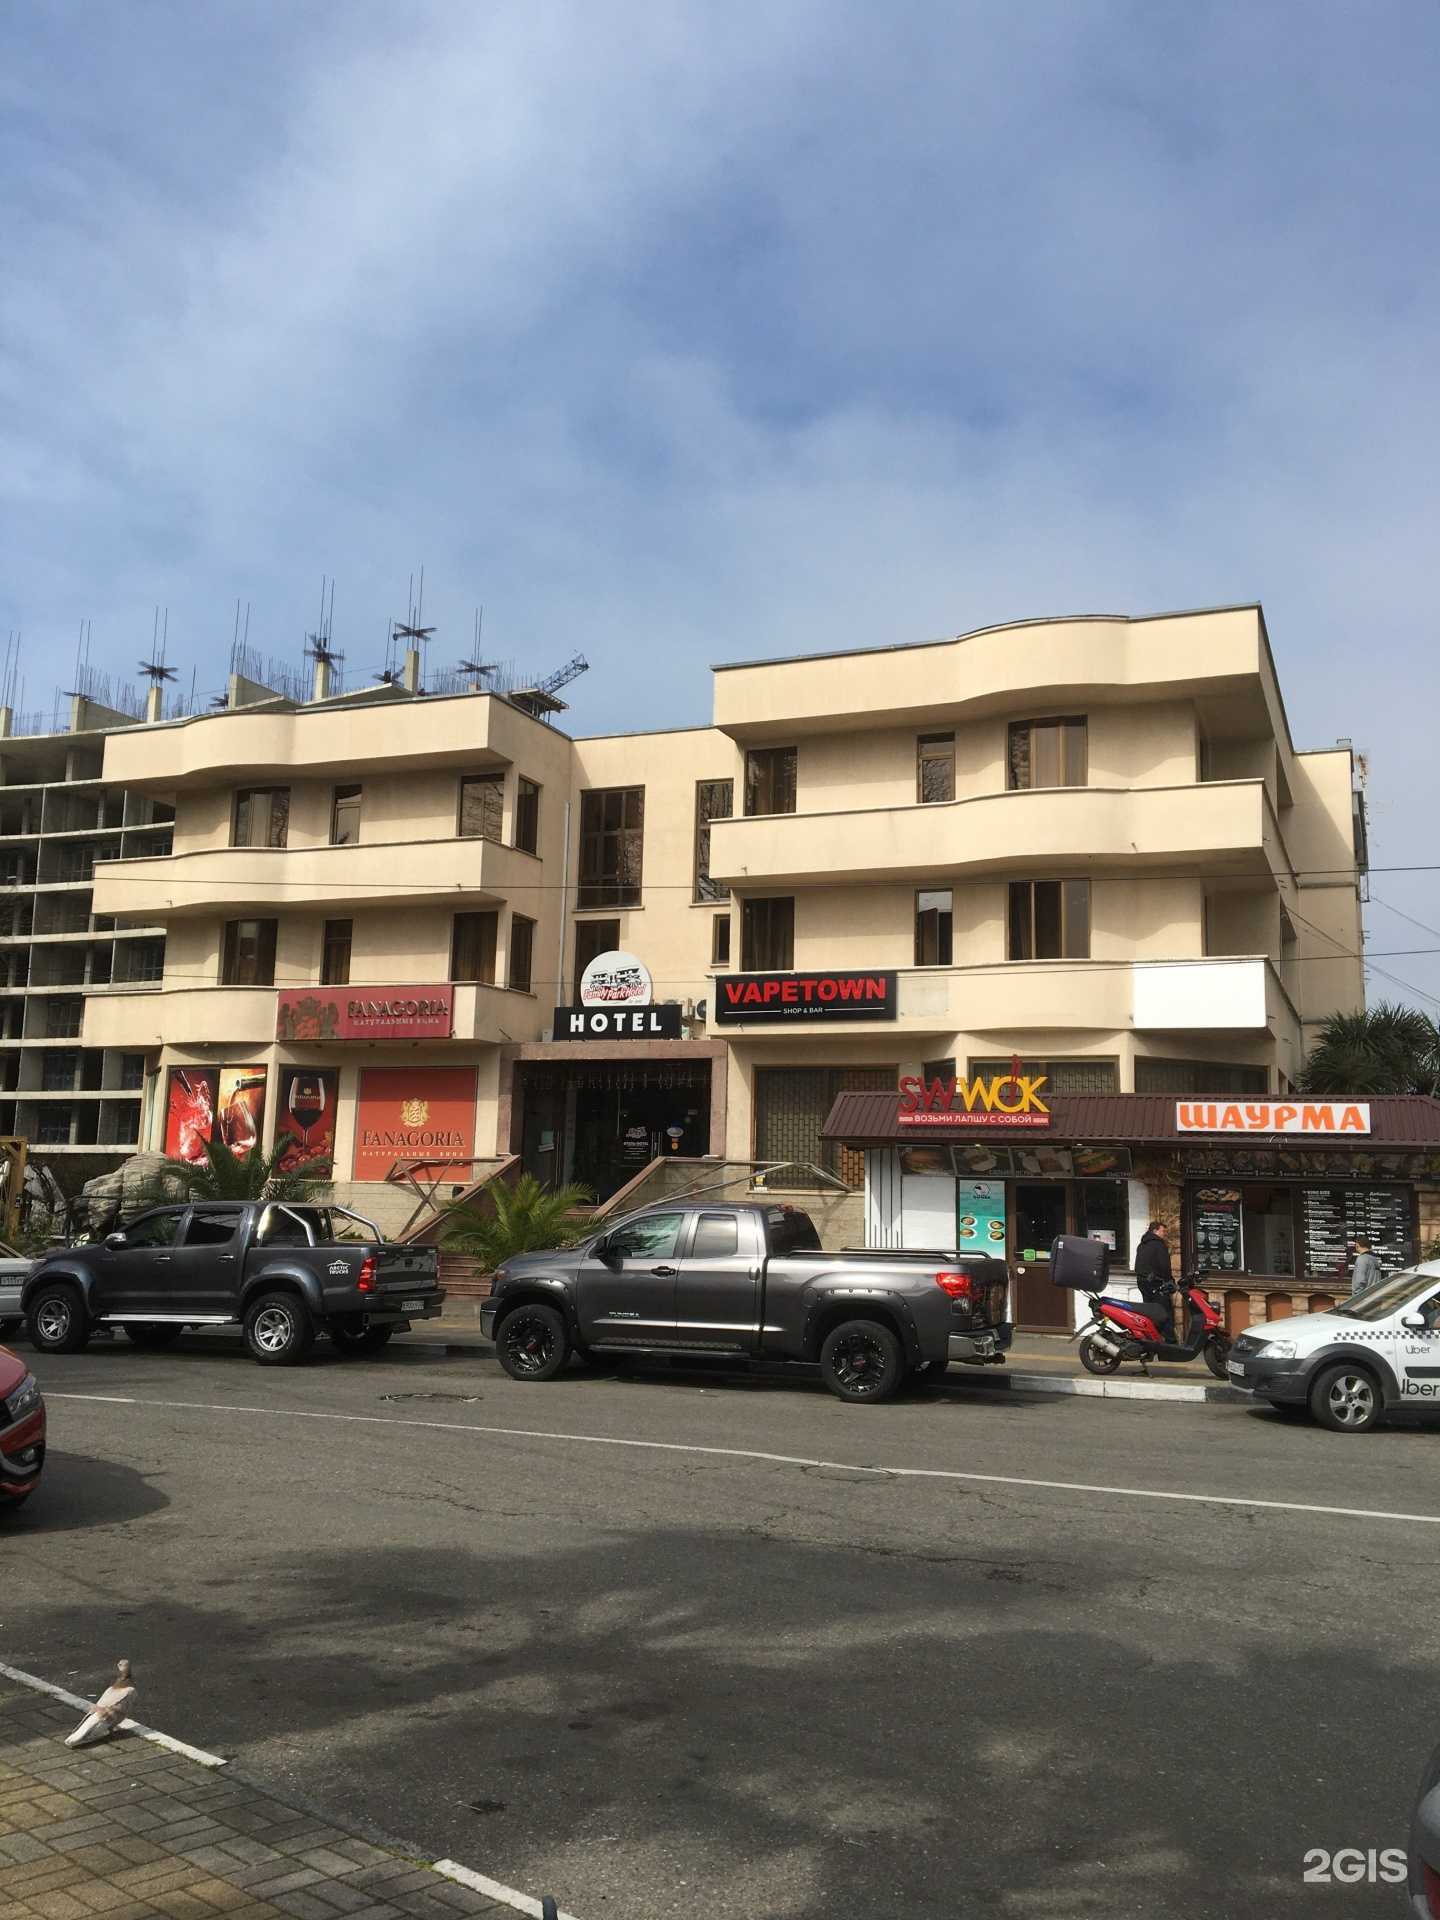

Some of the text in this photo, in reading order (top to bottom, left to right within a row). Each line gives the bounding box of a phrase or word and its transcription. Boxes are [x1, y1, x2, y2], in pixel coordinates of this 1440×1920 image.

[607, 988, 626, 1000] Park
[725, 977, 887, 1004] VAPETOWN
[348, 998, 449, 1018] FANAGORIA
[570, 1012, 662, 1032] HOTEL
[914, 1115, 953, 1123] ВОЗЬМИ
[954, 1115, 987, 1124] ЛАПШУ
[998, 1115, 1032, 1123] СОБОЙ
[1180, 1105, 1366, 1131] ШАУРМА
[363, 1131, 465, 1146] FANAGORIA
[1406, 1345, 1431, 1354] Uber
